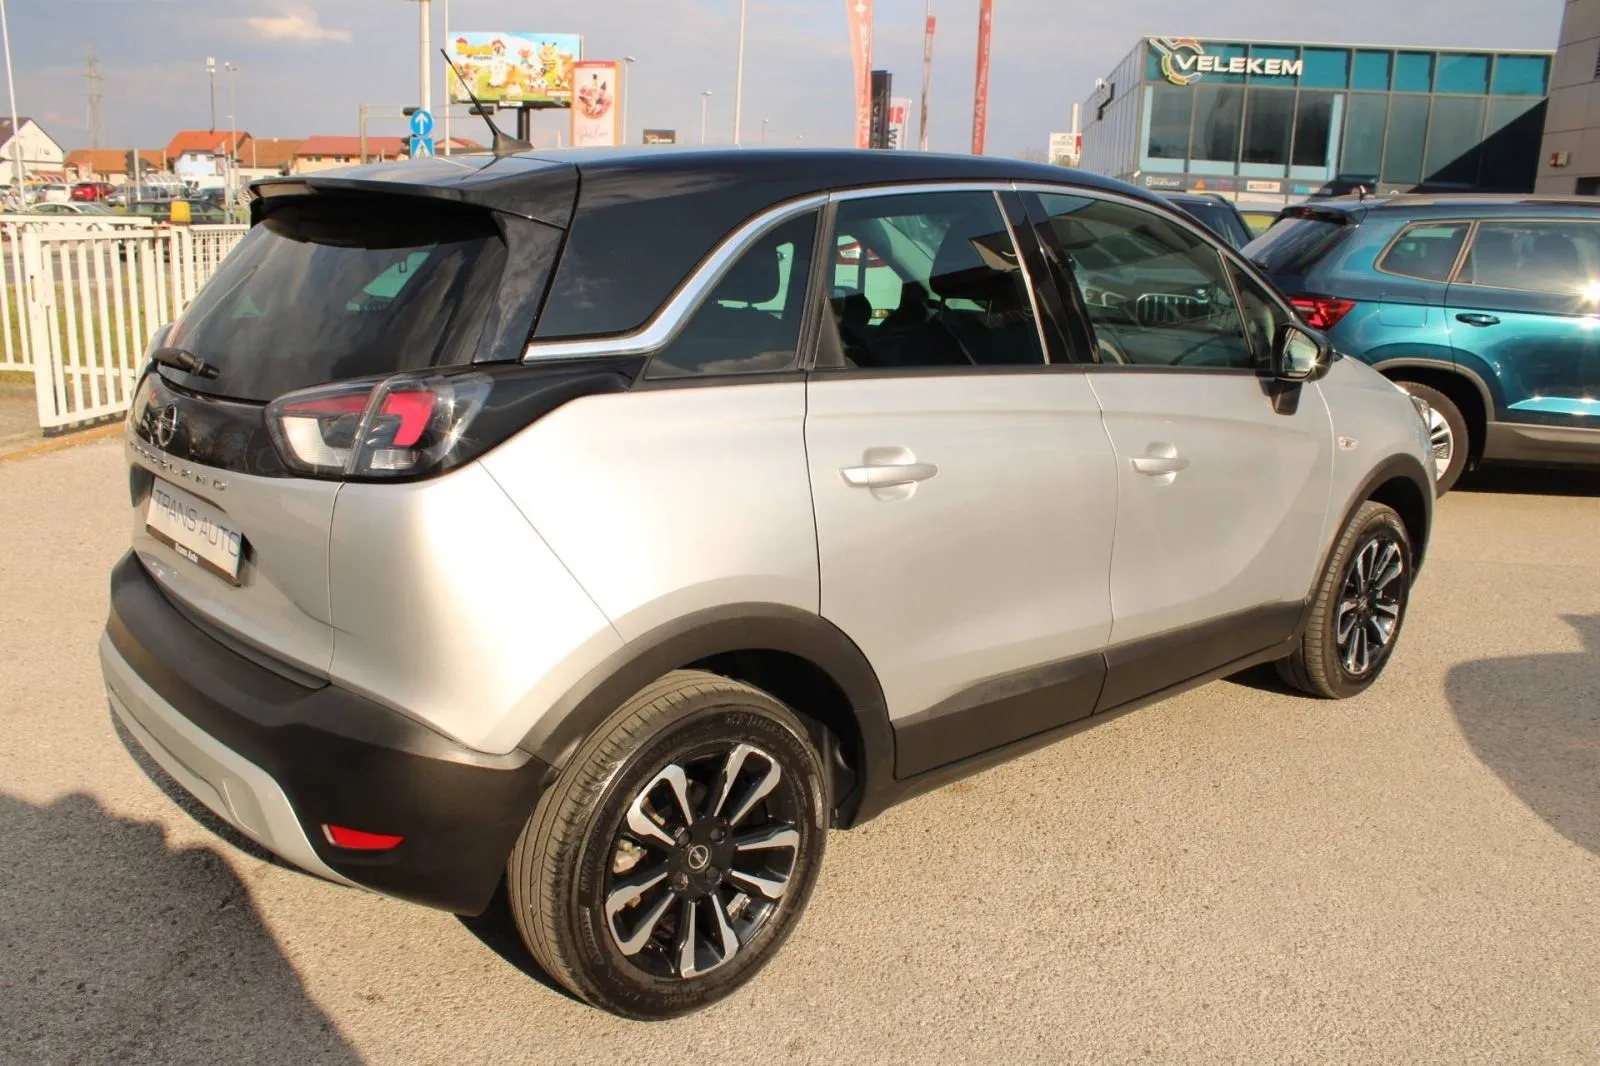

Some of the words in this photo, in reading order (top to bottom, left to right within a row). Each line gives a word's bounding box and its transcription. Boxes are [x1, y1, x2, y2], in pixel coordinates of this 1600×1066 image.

[1174, 54, 1304, 76] VELEKEM
[155, 488, 198, 533] TRANS
[198, 516, 241, 557] AUTO
